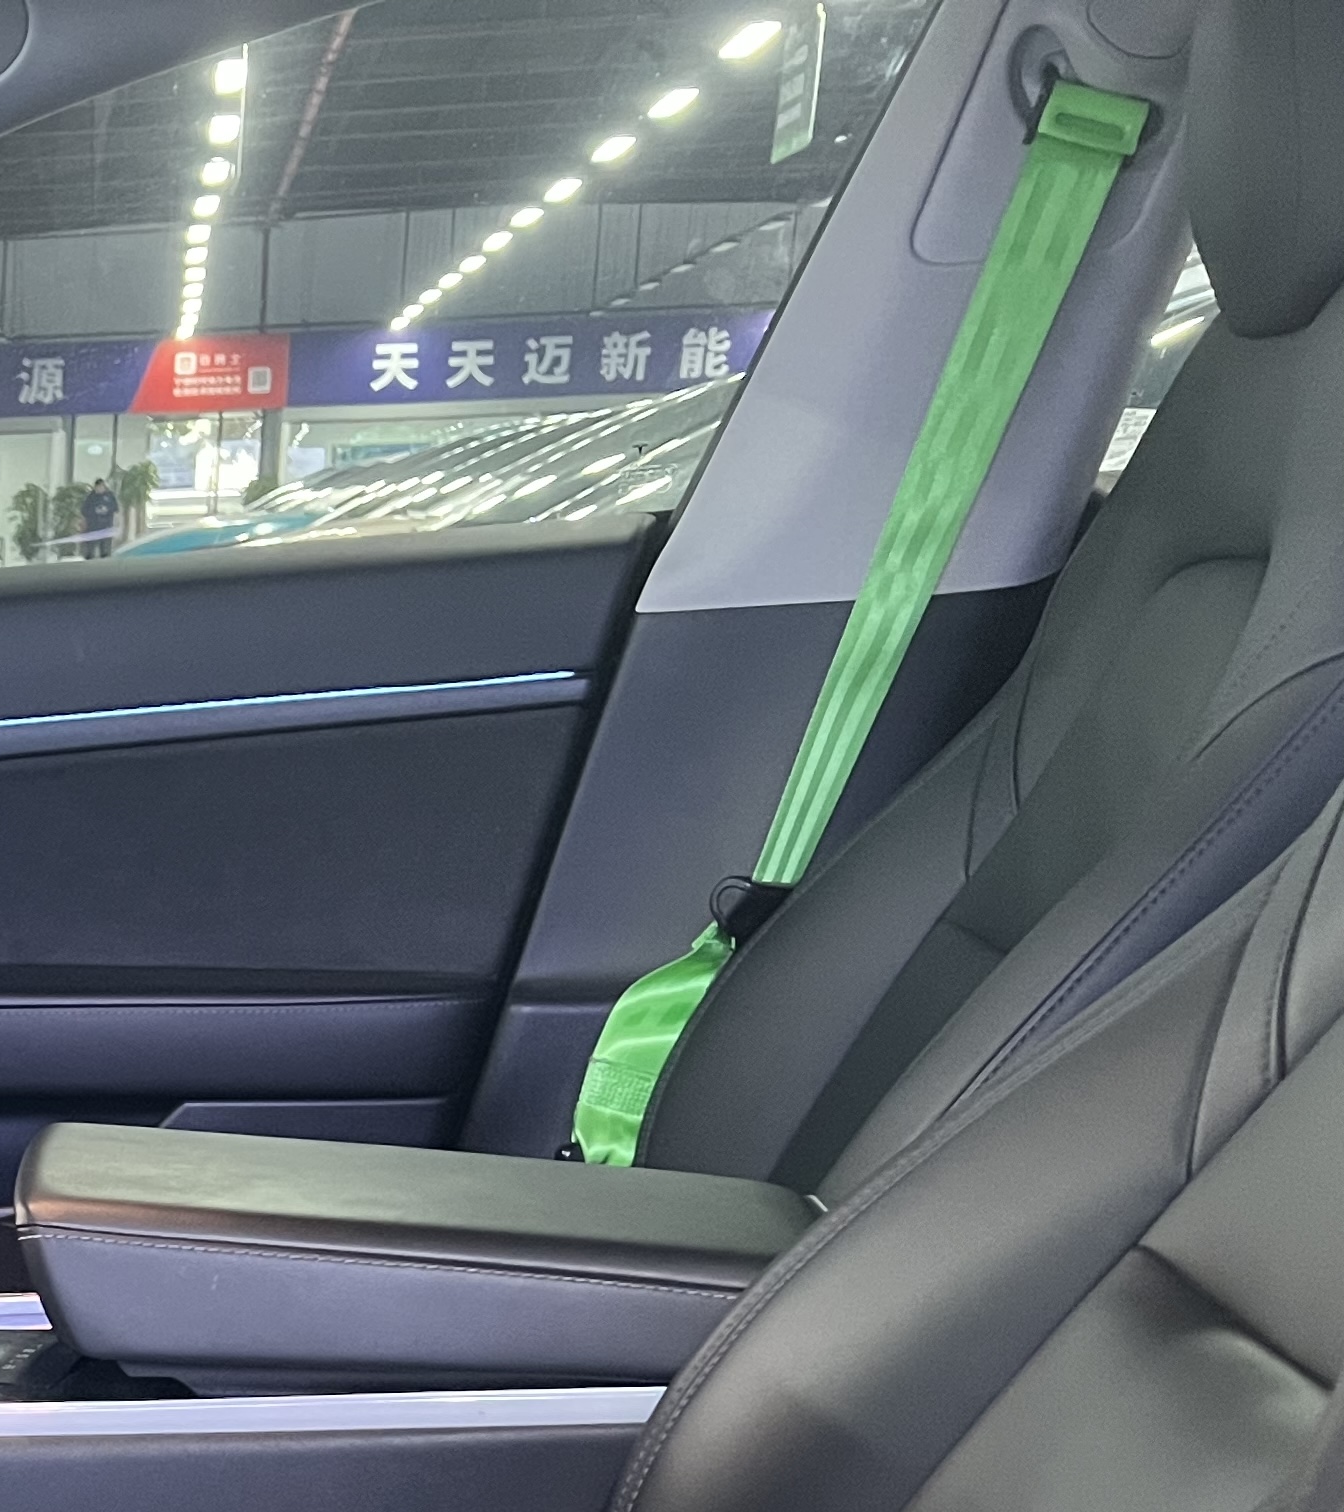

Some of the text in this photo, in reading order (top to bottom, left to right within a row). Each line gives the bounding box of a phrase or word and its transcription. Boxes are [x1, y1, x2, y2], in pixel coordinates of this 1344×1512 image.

[369, 327, 732, 392] 天天迈新能
